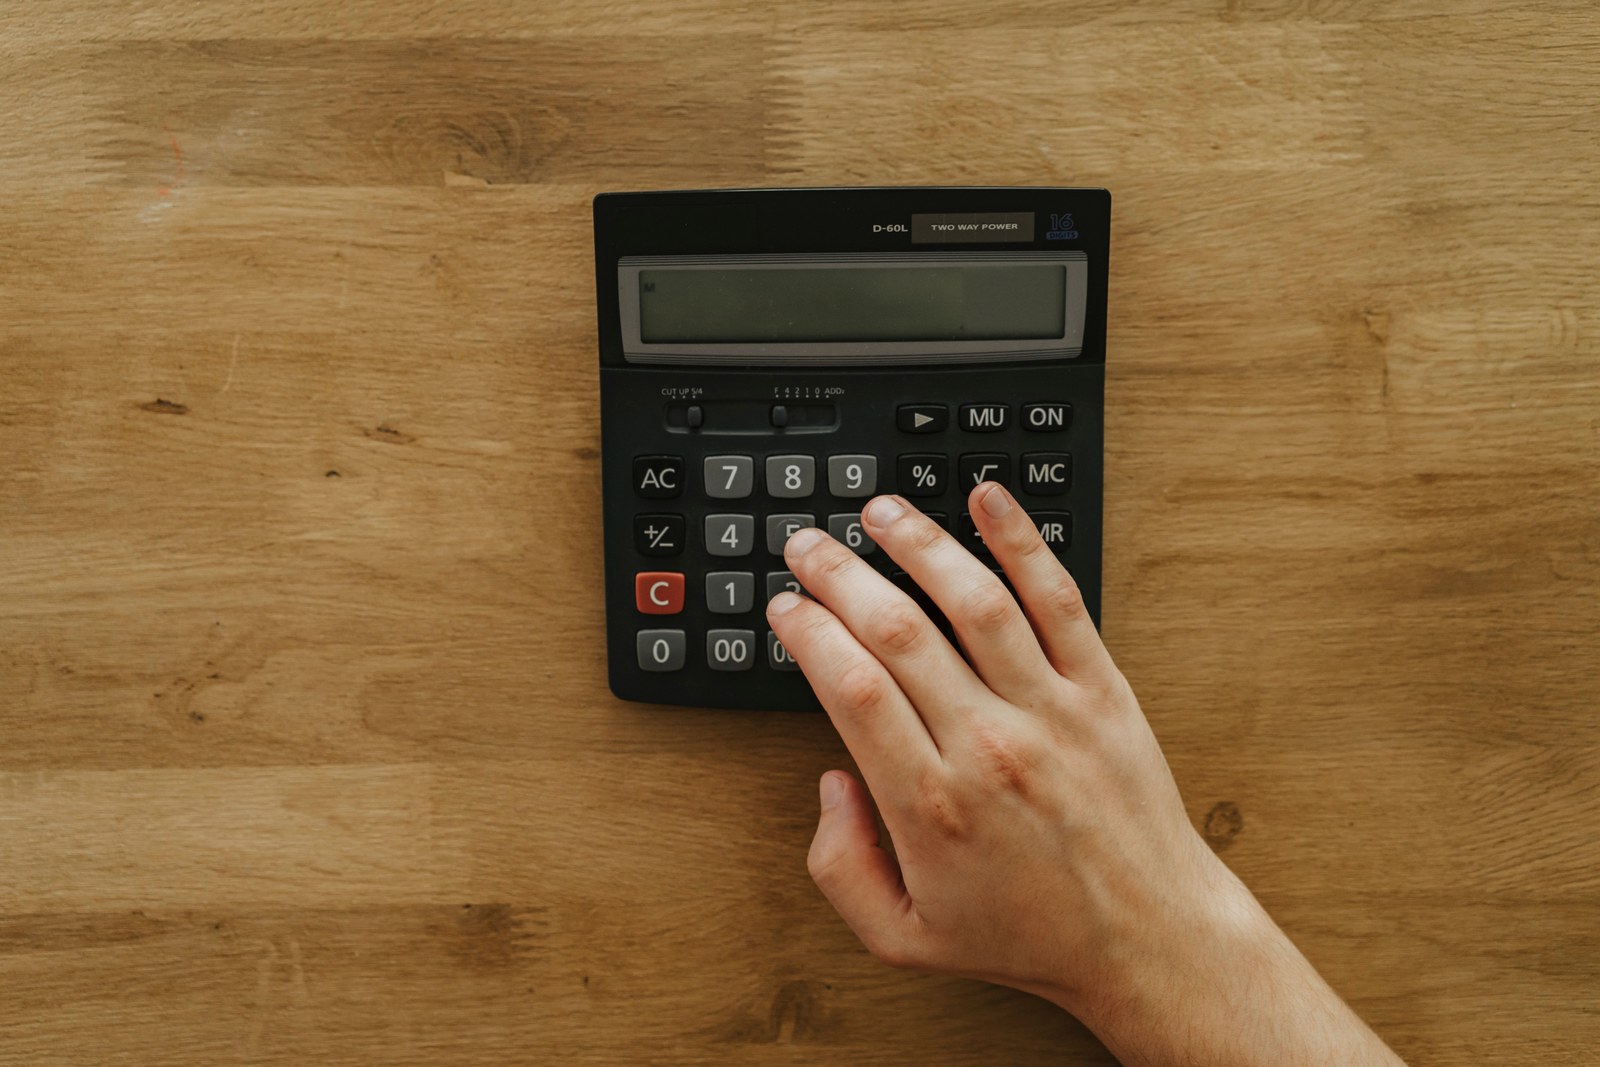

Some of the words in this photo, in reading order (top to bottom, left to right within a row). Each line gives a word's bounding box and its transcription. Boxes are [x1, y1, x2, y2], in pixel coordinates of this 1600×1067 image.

[872, 224, 909, 233] D-60L
[957, 223, 979, 231] WAY
[1049, 213, 1074, 231] 16
[1047, 231, 1077, 239] DIGITS
[661, 388, 677, 396] CUT
[969, 408, 1005, 427] MU
[1029, 407, 1063, 426] ON
[640, 468, 676, 489] AC
[722, 465, 738, 489] 7
[784, 464, 802, 490] 8
[845, 464, 863, 489] 9
[1028, 463, 1065, 483] MC
[720, 524, 739, 548] 4
[845, 523, 862, 548] 6
[650, 581, 669, 606] C
[724, 582, 735, 606] 1
[652, 639, 670, 663] 0
[714, 639, 747, 663] 00
